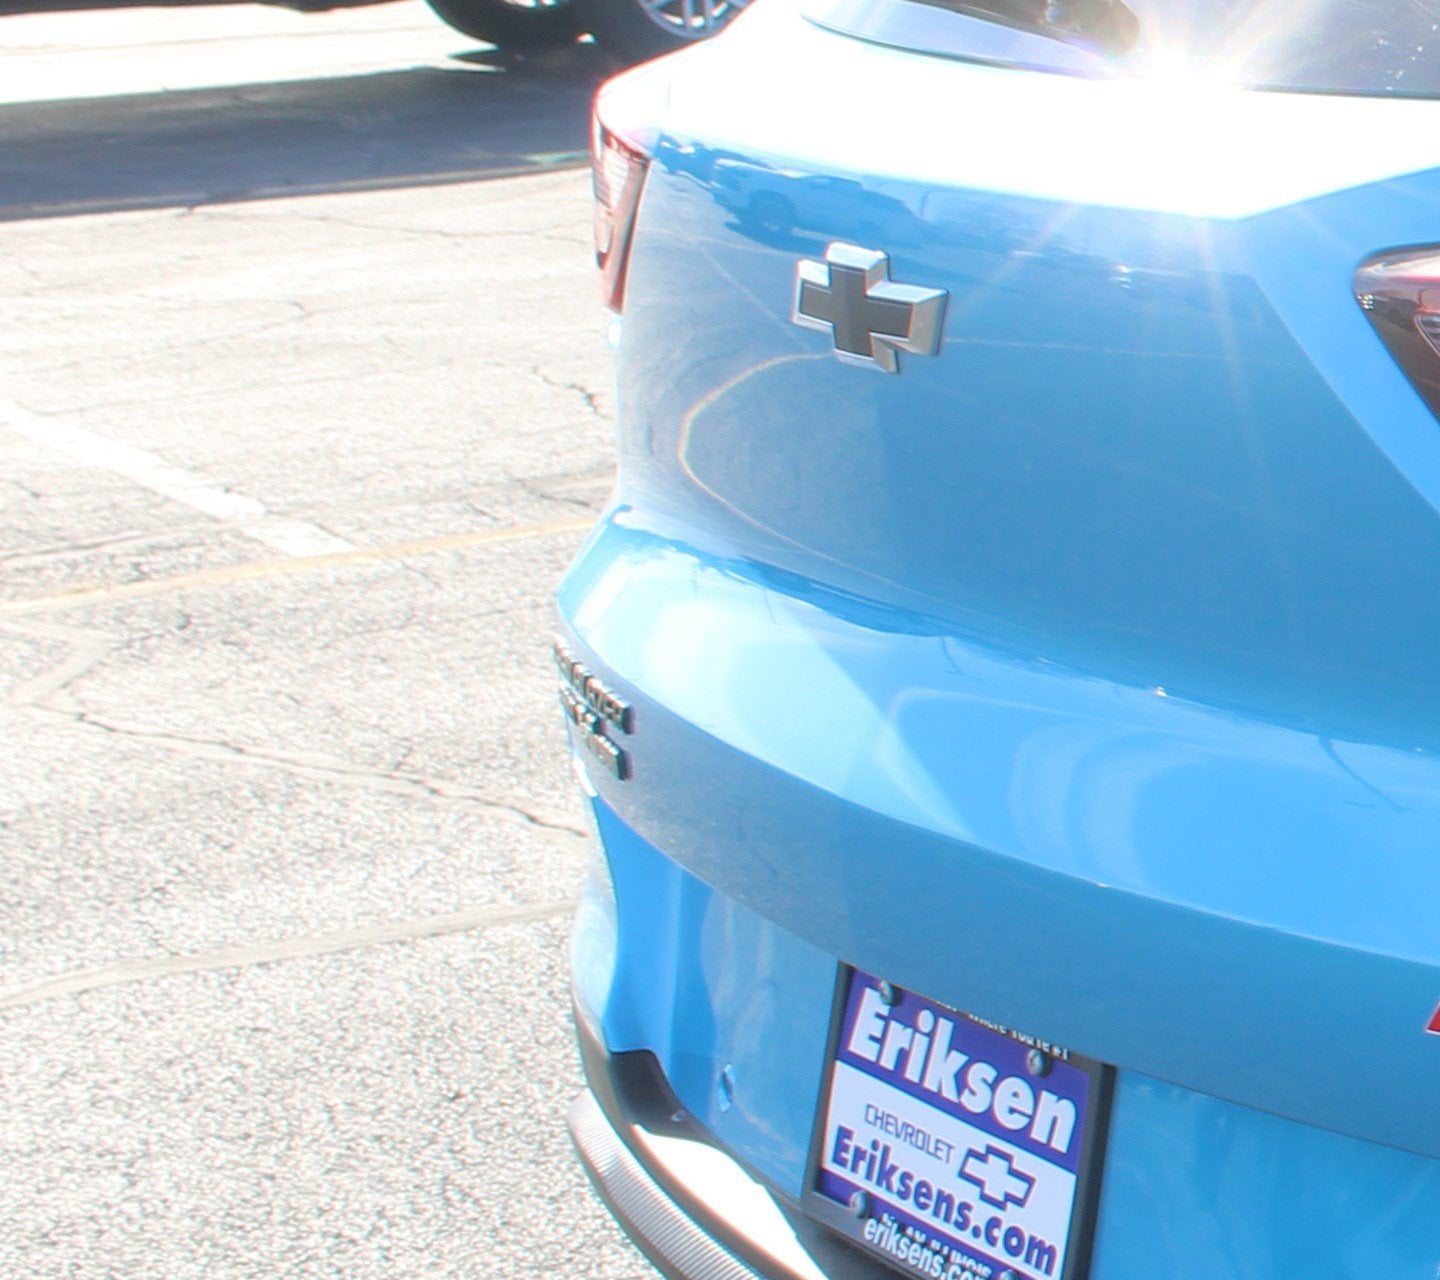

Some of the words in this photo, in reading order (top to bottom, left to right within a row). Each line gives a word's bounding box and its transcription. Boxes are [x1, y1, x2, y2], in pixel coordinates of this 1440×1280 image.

[847, 987, 1077, 1153] Eriksen
[864, 1103, 956, 1165] CHEVROLET
[831, 1123, 1059, 1278] Eriksens.com
